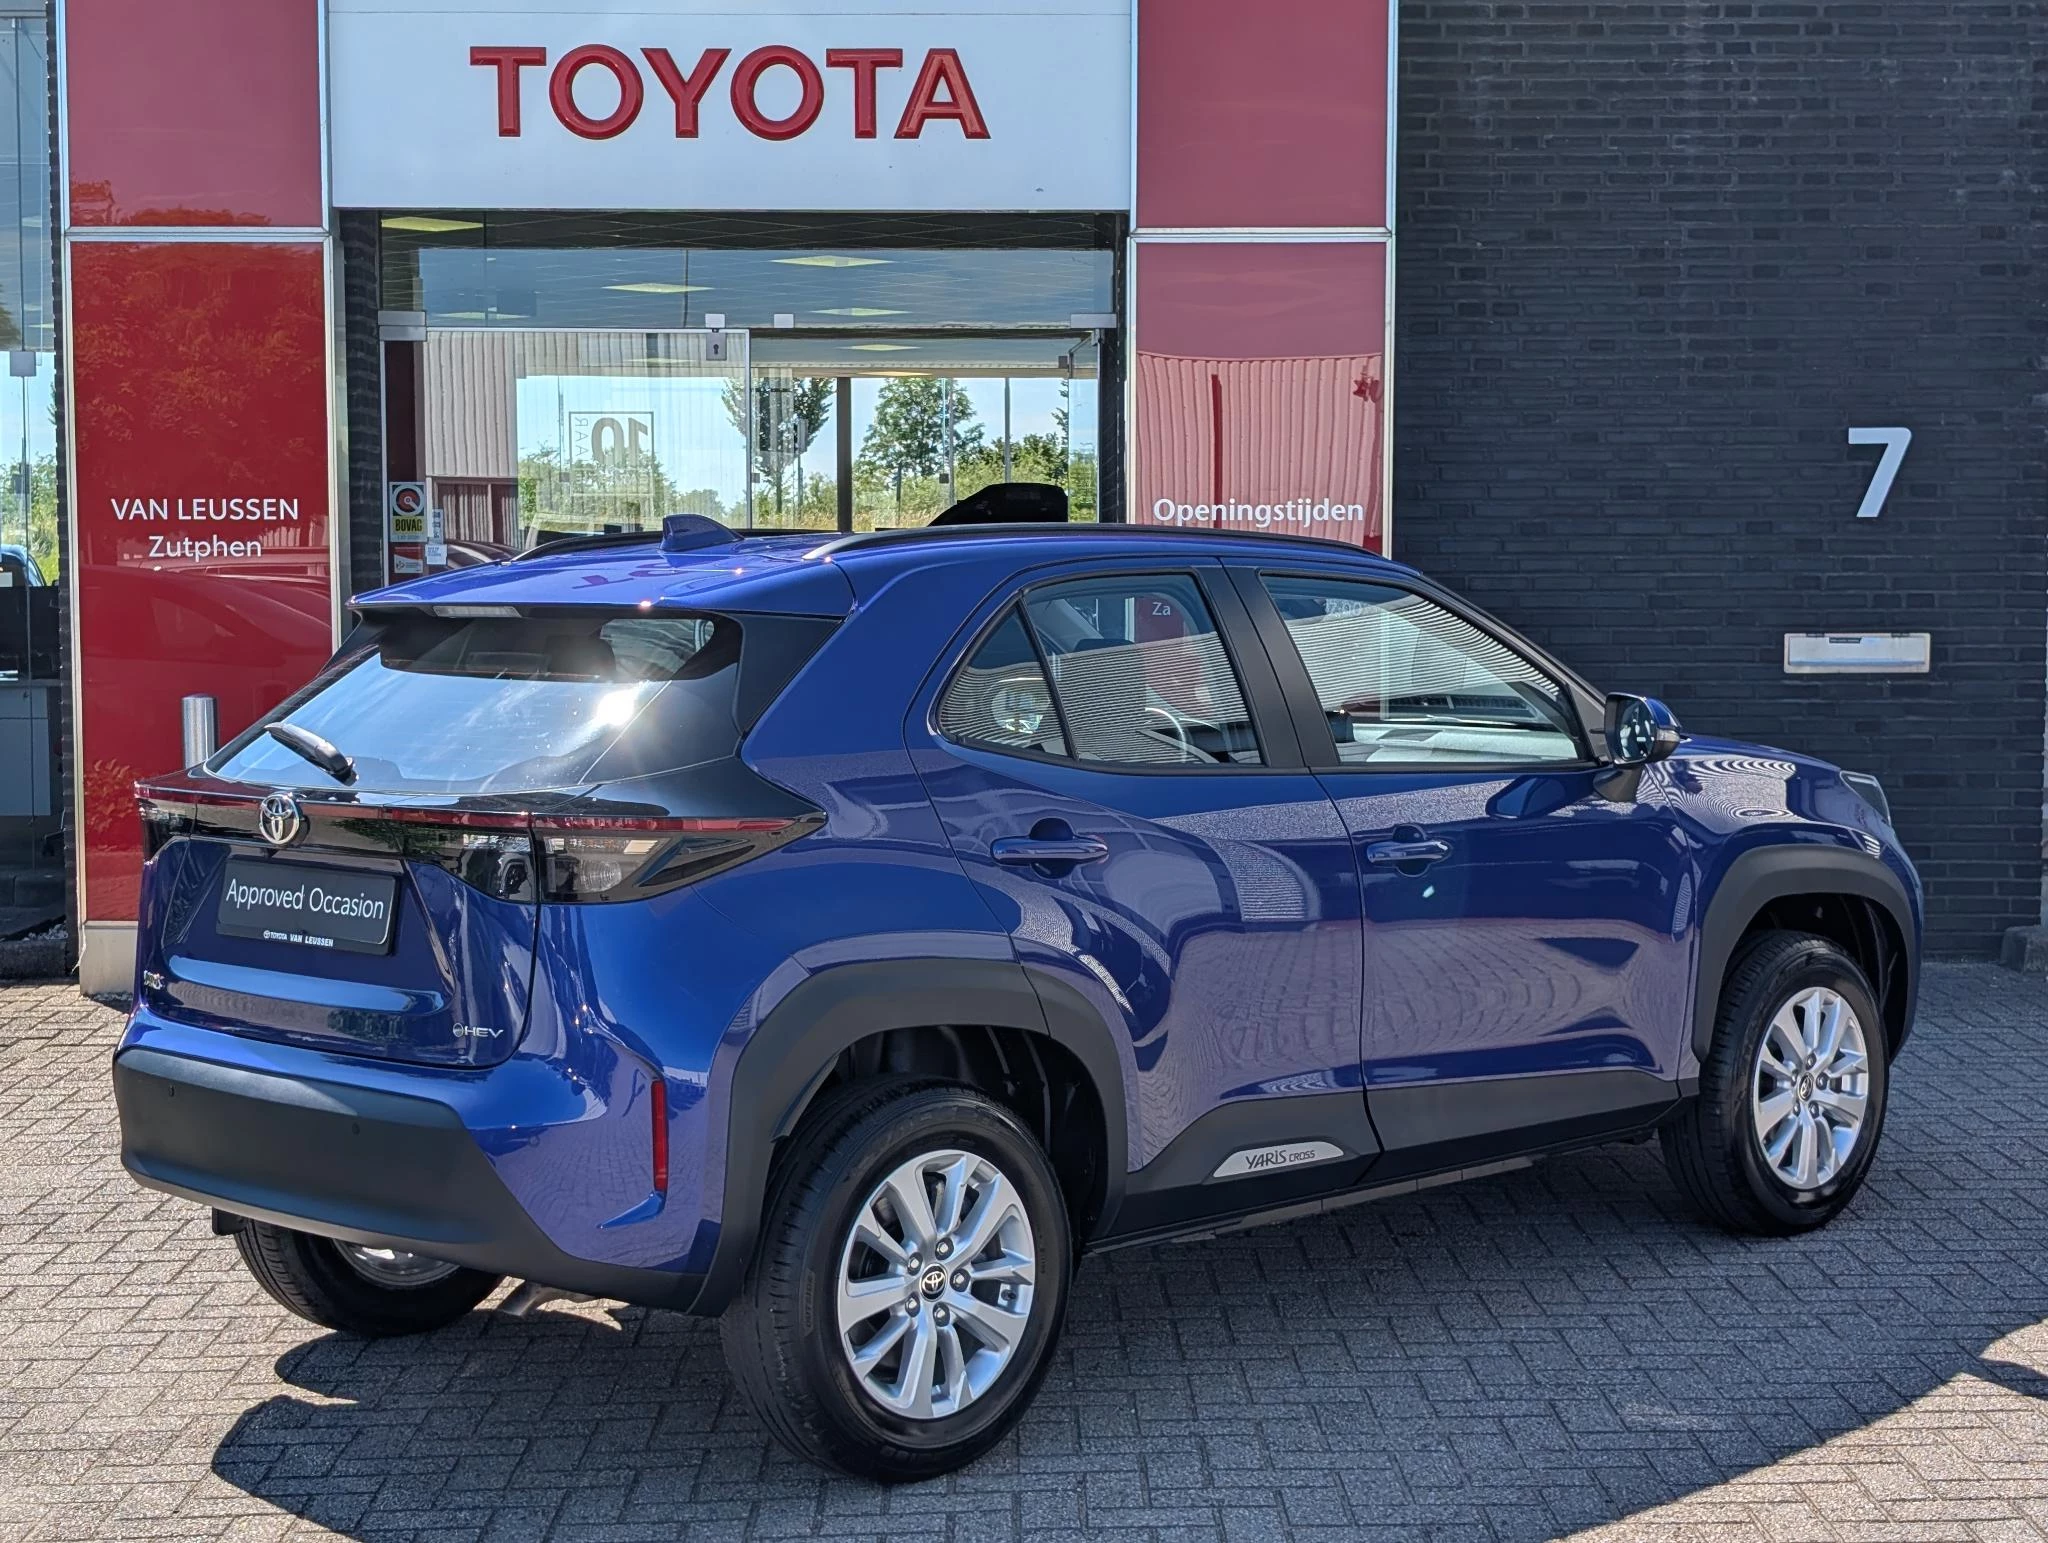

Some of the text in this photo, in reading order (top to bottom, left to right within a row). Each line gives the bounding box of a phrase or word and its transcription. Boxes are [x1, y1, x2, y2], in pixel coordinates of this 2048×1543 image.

[470, 43, 992, 141] TOYOTA
[1848, 427, 1912, 517] 7
[111, 498, 299, 521] VAN LEUSSEN
[1153, 498, 1364, 528] Openingstijden
[395, 518, 423, 532] BOVAG
[148, 534, 262, 563] Zutphen
[1152, 602, 1171, 616] Za
[227, 878, 384, 919] Approved Occasion
[270, 931, 333, 946] TOYOTA VAN LEUSSEN
[464, 1026, 504, 1038] HEV
[1288, 1149, 1316, 1163] CROSS
